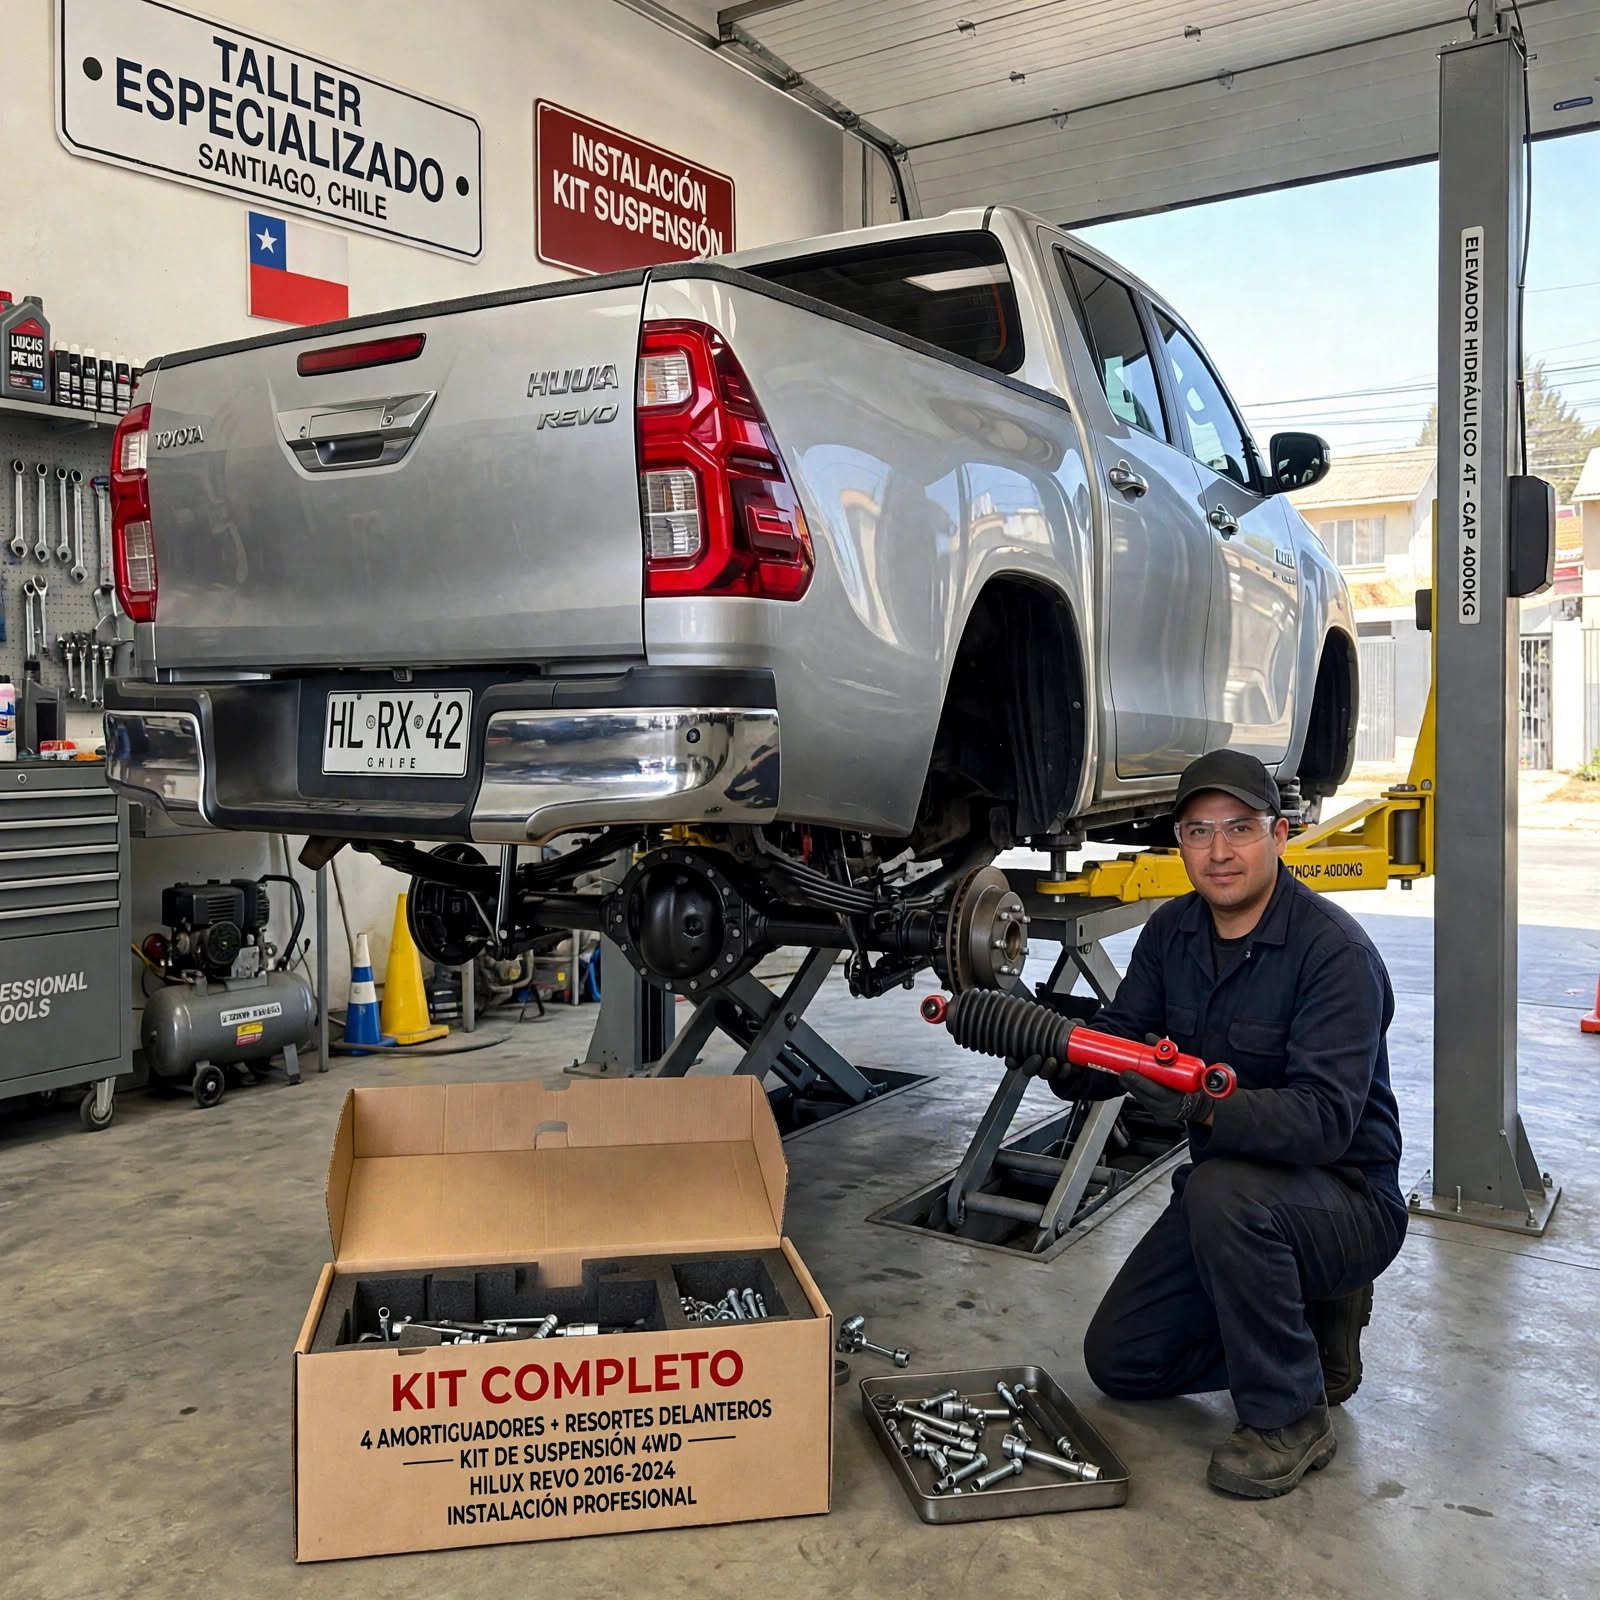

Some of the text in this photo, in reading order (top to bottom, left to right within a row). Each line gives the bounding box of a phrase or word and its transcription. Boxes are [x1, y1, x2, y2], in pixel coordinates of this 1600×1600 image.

[213, 36, 361, 127] TALLER
[116, 57, 445, 202] ESPECIALIZADO
[199, 143, 387, 220] SANTIAGO, CHILE
[572, 132, 706, 215] INSTALACIÓN
[553, 169, 723, 257] KIT SUSPENSIÓN
[1464, 236, 1479, 333] ELEVADOR
[536, 403, 619, 430] REVO
[1463, 339, 1481, 457] HIDRÁULICO
[155, 425, 204, 450] TOYOTA
[1463, 463, 1476, 484] 4T
[1463, 502, 1476, 539] CAP
[1463, 546, 1476, 616] 4000KG
[0, 998, 51, 1024] OOLS
[393, 1349, 743, 1412] KIT COMPLETO
[360, 1399, 772, 1450] 4 AMORTIGUADORES + RESORTES DELANTEROS
[460, 1431, 682, 1469] KIT DE SUSPENSIÓN 4WD
[448, 1485, 697, 1525] INSTALACIÓN PROFESIONAL
[470, 1460, 676, 1495] HILUX REVO 2016-2024
